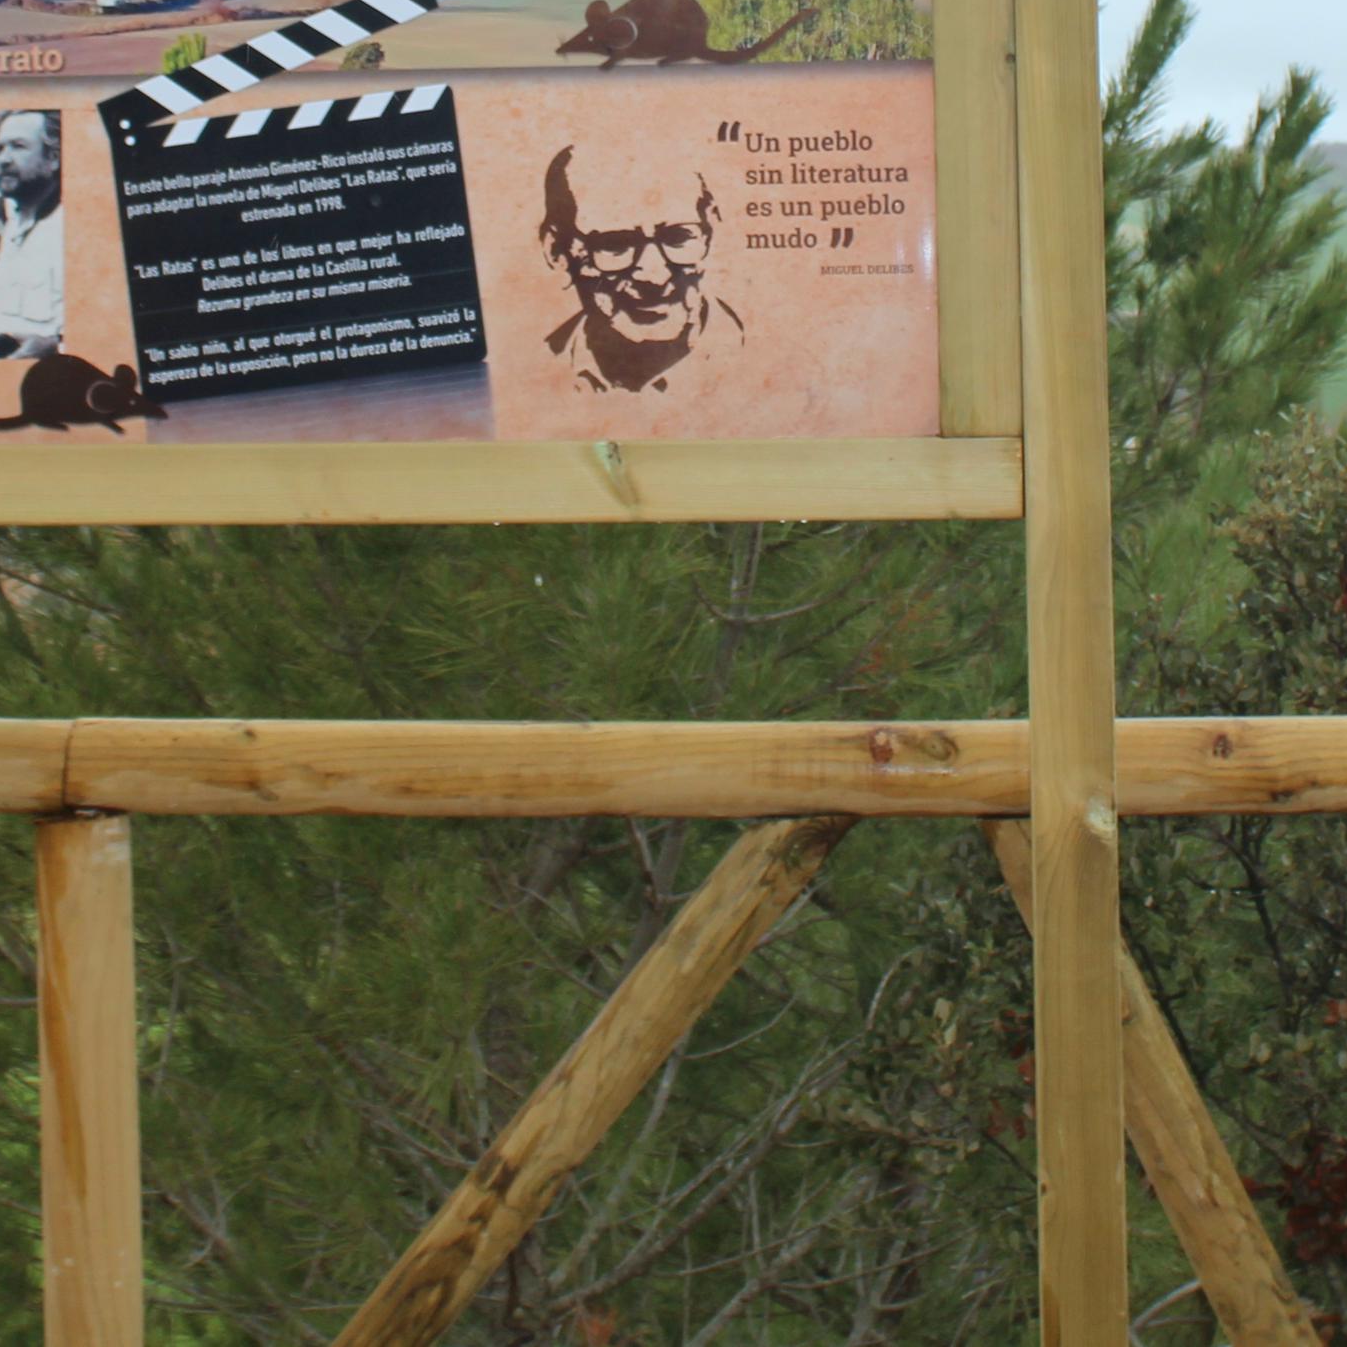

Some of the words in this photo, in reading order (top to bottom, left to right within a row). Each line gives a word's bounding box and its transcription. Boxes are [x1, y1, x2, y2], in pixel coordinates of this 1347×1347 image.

[788, 129, 873, 157] pueblo
[124, 181, 138, 196] En
[140, 180, 162, 194] este
[163, 173, 191, 190] bello
[192, 169, 226, 189] paraje
[228, 164, 269, 181] Antonio
[347, 147, 385, 165] instaló
[386, 147, 406, 161] sus
[407, 141, 454, 158] cámaras
[745, 163, 783, 185] sin
[791, 163, 909, 185] literatura
[127, 203, 151, 219] para
[153, 197, 194, 213] adaptar
[196, 194, 207, 206] la
[209, 189, 245, 205] novela
[246, 187, 260, 200] de
[260, 181, 299, 200] Miguel
[300, 176, 341, 194] Delibes
[406, 165, 427, 181] que
[241, 203, 296, 223] estrenada
[298, 201, 313, 215] en
[745, 202, 772, 217] es
[781, 201, 813, 216] un
[820, 193, 906, 221] pueblo
[201, 258, 215, 271] es
[218, 255, 240, 268] uno
[243, 251, 258, 265] de
[260, 248, 279, 263] los
[281, 244, 315, 260] libros
[317, 243, 333, 255] en
[335, 239, 357, 255] que
[360, 233, 392, 250] mejor
[396, 231, 412, 244] ha
[414, 223, 465, 242] reflejado
[202, 275, 244, 292] Delibes
[245, 272, 257, 287] el
[258, 268, 295, 284] drama
[296, 265, 311, 279] de
[312, 263, 324, 276] la
[325, 258, 369, 275] Castilla
[370, 253, 401, 269] rural.
[821, 265, 865, 276] MIGUEL
[867, 264, 914, 275] DELIBES
[197, 297, 241, 314] Rezuma
[243, 290, 294, 311] grandeza
[295, 288, 310, 300] en
[312, 286, 326, 299] su
[328, 280, 366, 296] misma
[368, 273, 412, 291] miseria.
[168, 343, 199, 360] sabio
[233, 337, 245, 352] al
[248, 336, 270, 351] que
[273, 327, 316, 347] otorgué
[320, 326, 331, 340] el
[335, 318, 415, 341] protagonismo,
[417, 309, 460, 328] suavizó
[463, 308, 476, 321] la
[148, 367, 198, 385] aspereza
[199, 363, 214, 377] de
[215, 361, 227, 375] la
[293, 352, 318, 368] pero
[320, 349, 335, 361] no
[336, 346, 349, 360] la
[349, 342, 388, 358] dureza
[389, 339, 404, 352] de
[405, 337, 418, 350] la
